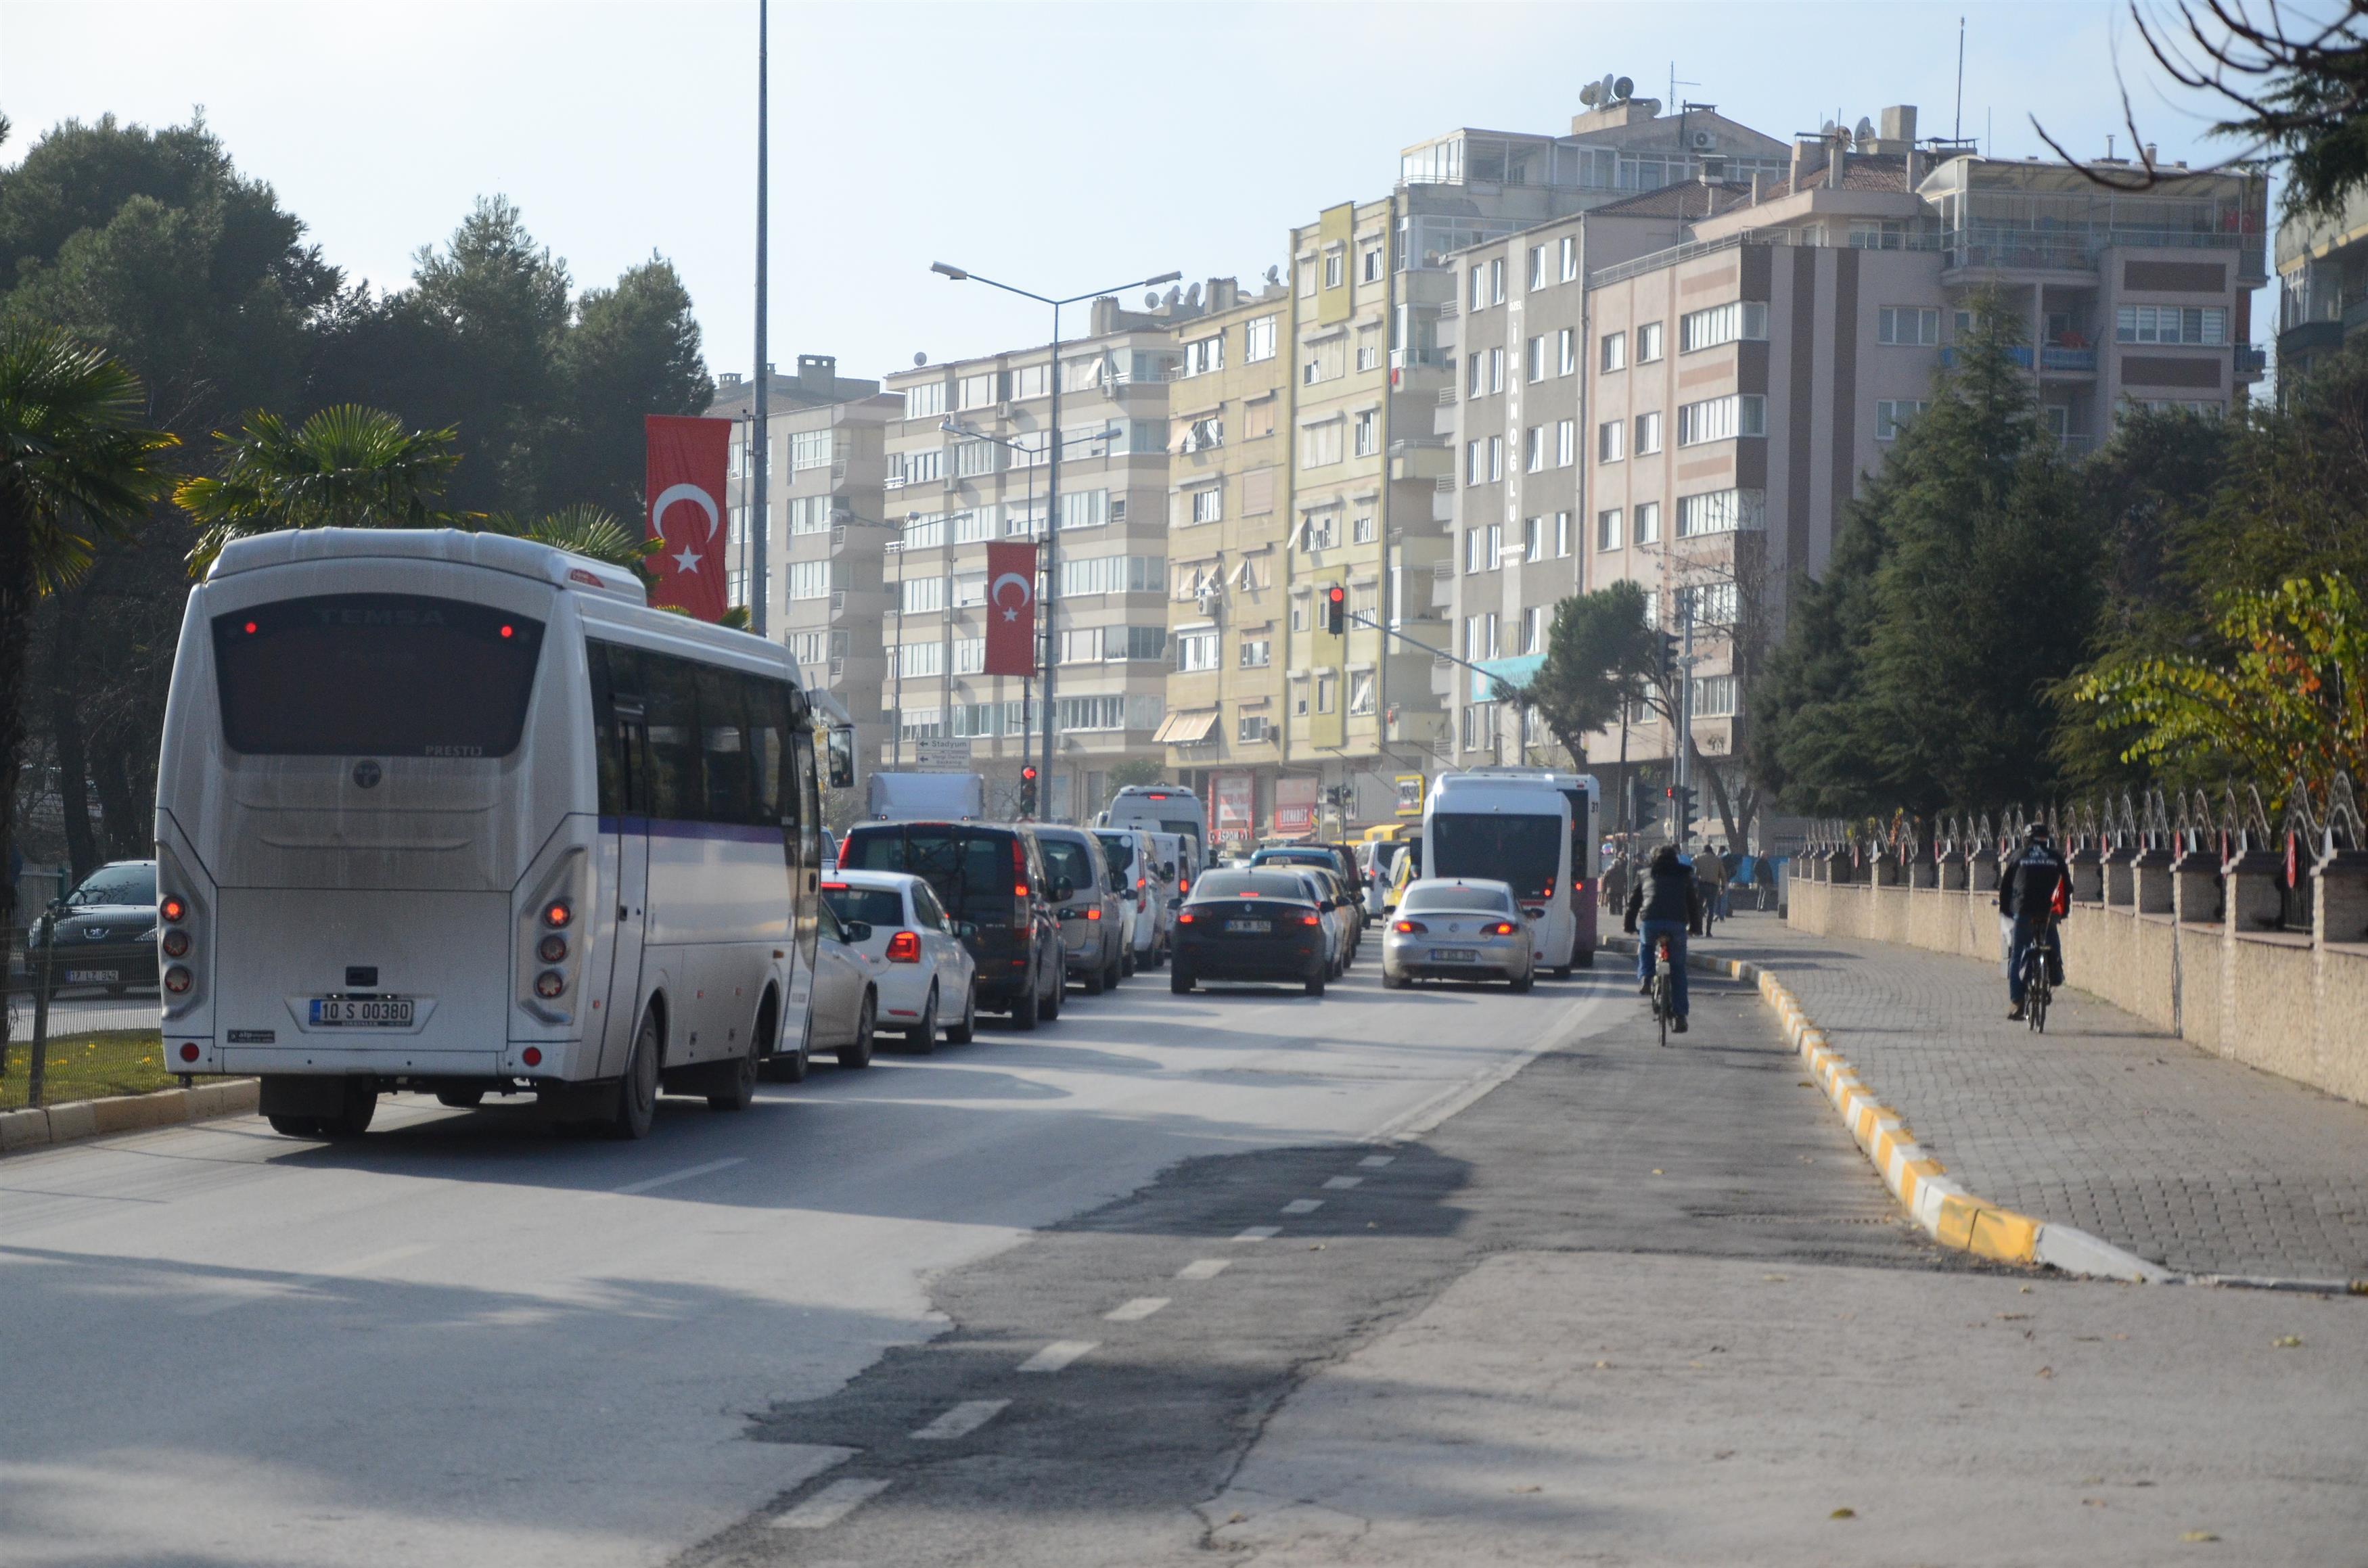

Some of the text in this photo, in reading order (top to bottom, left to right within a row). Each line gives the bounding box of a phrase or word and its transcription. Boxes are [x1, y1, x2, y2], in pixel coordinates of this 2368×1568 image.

[1509, 300, 1522, 313] ÖZEL
[321, 609, 443, 624] TEMSA
[932, 741, 967, 749] Stadyum
[1591, 802, 1599, 813] 31
[323, 1003, 408, 1019] 10 S 00380
